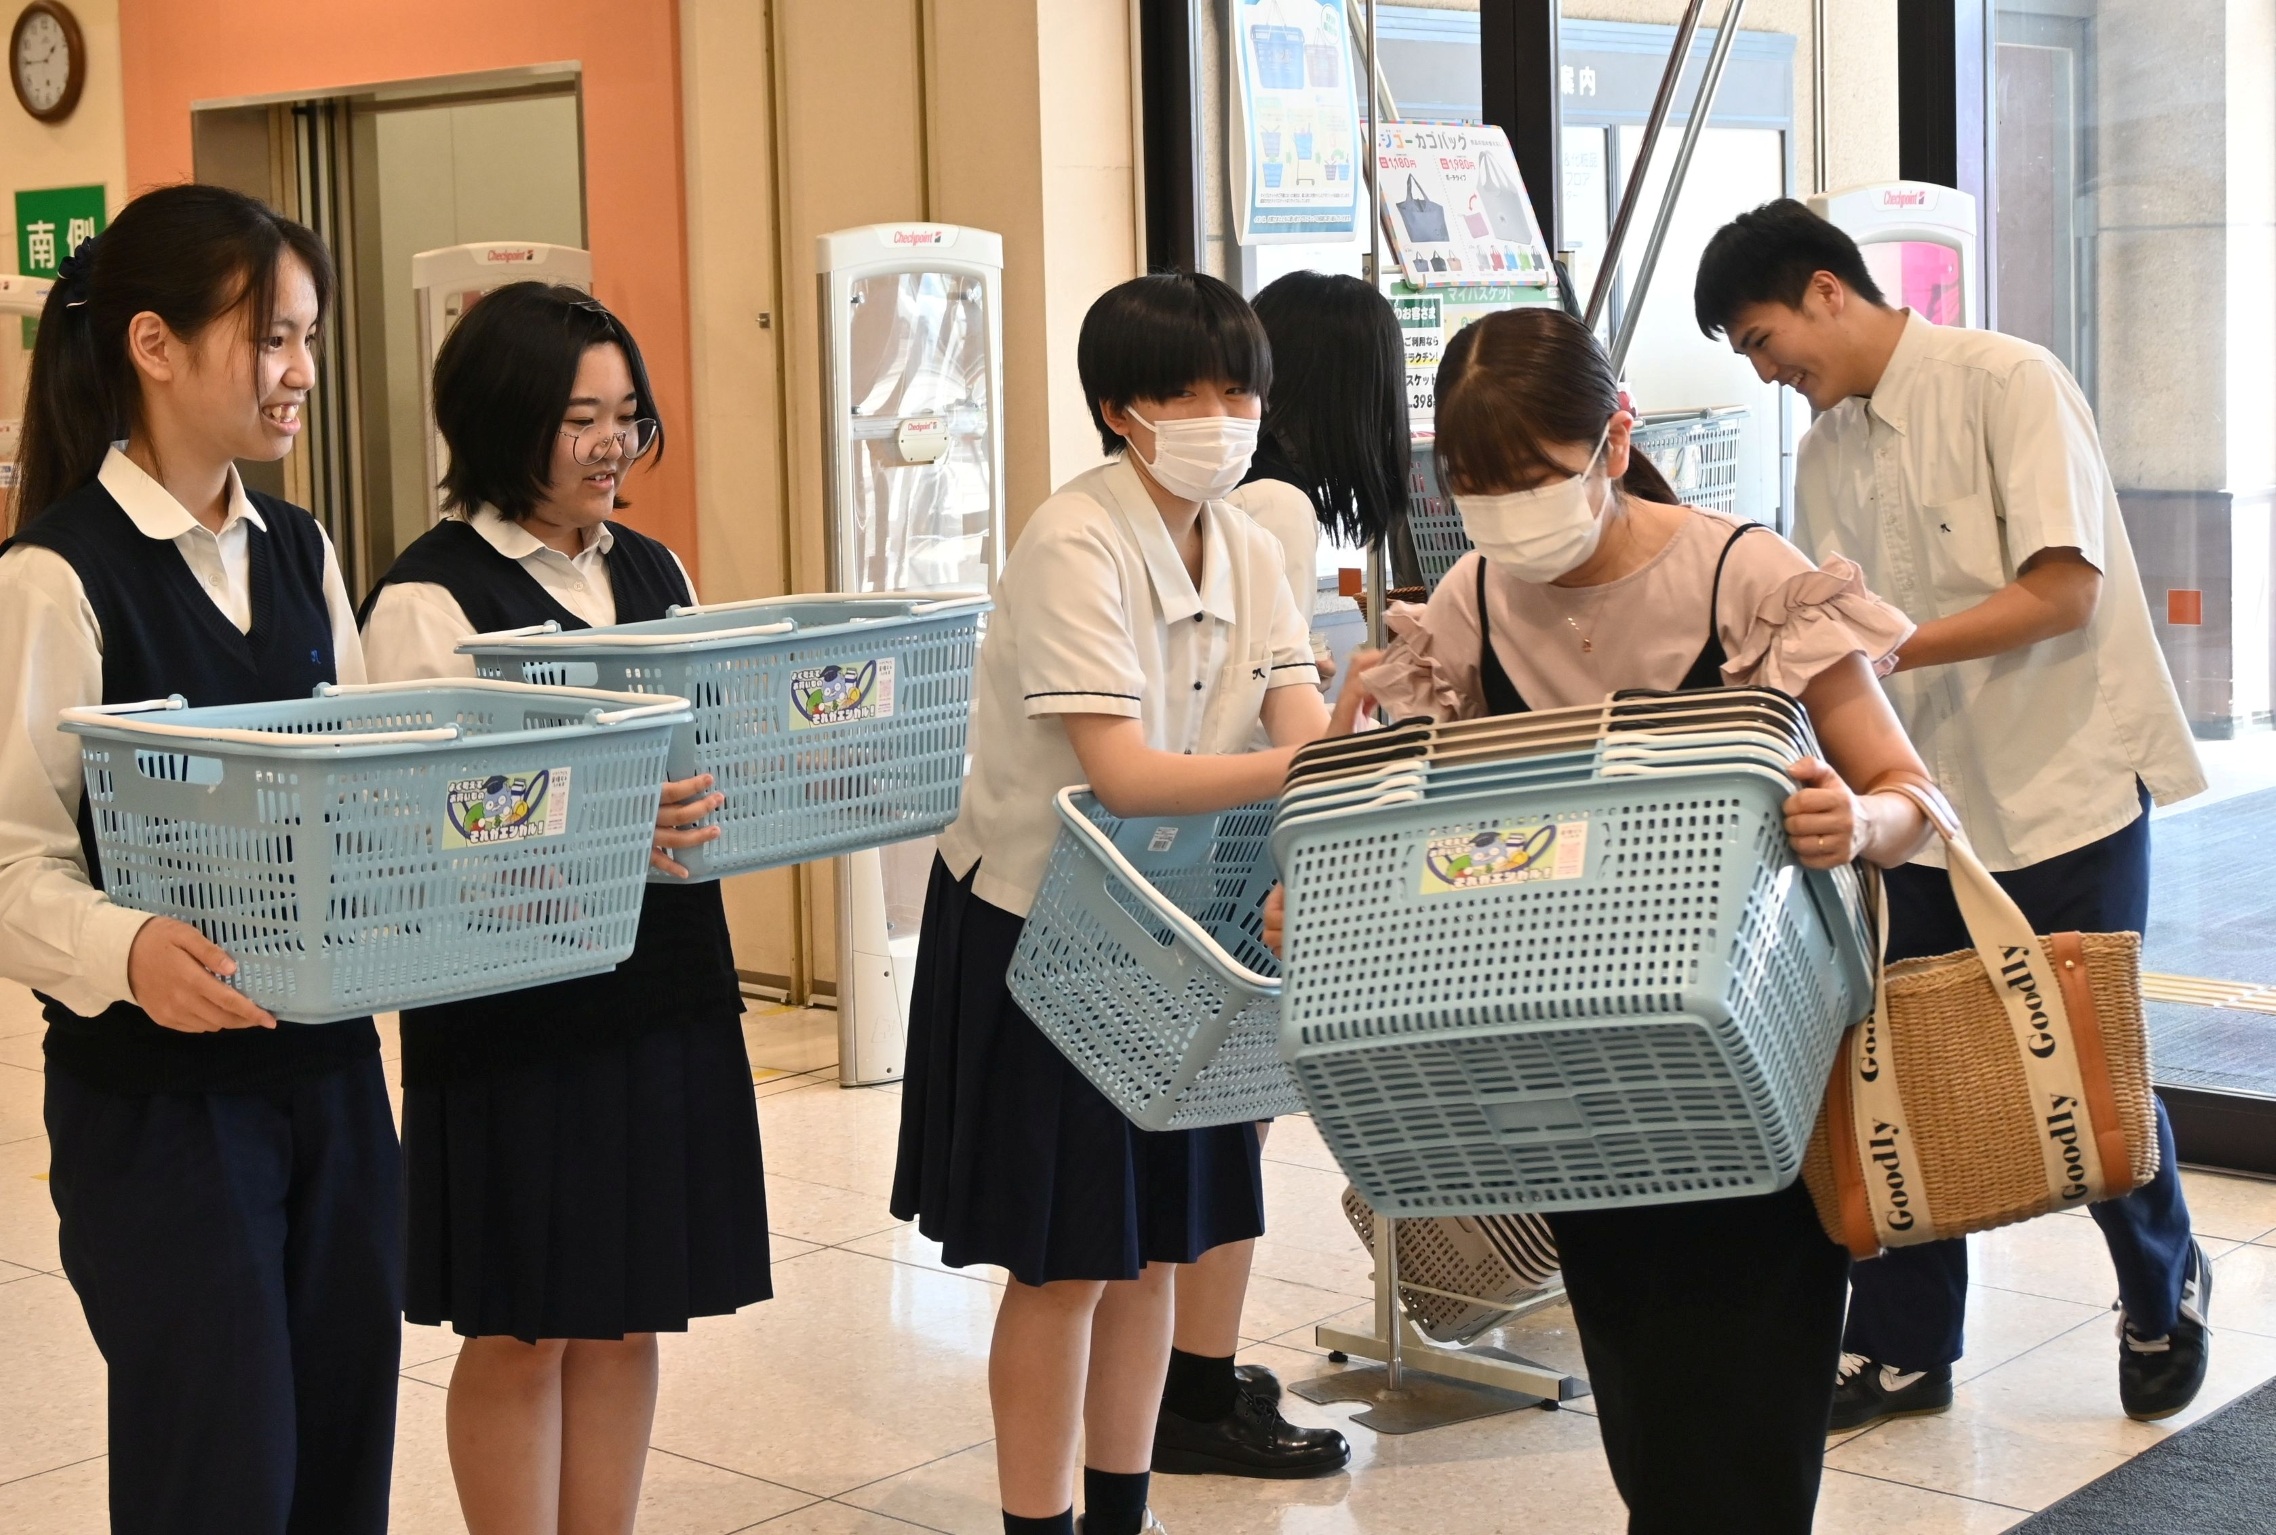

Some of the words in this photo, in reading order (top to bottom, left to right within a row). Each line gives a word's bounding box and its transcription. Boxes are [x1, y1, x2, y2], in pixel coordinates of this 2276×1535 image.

[1379, 129, 1467, 151] ジゴーカゴバッグ
[1884, 190, 1917, 208] Checkpoint
[894, 231, 933, 246] Checkpoint
[487, 249, 526, 263] Checkpoint
[908, 422, 931, 432] Checkpoint
[1998, 944, 2056, 1059] Goodly
[2046, 1093, 2089, 1201] Goodly
[1869, 1117, 1914, 1232] Goodly
